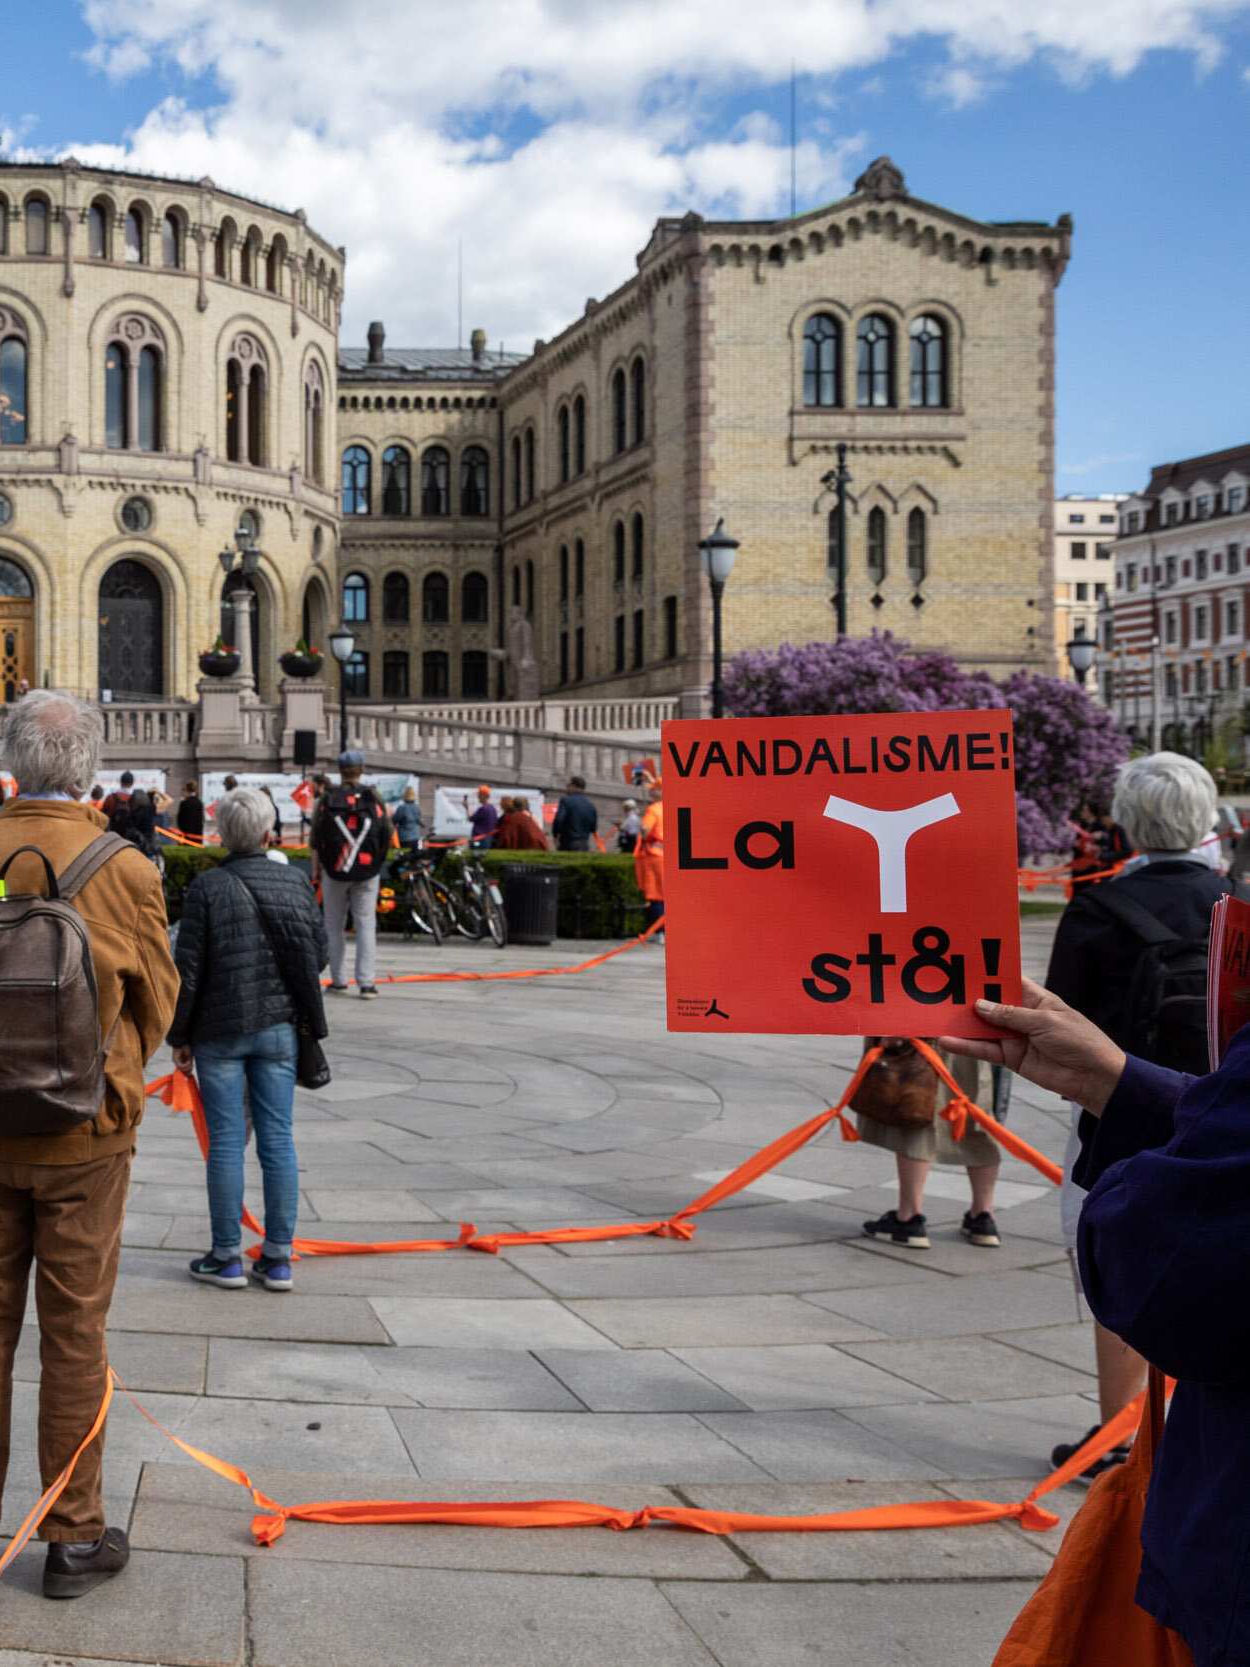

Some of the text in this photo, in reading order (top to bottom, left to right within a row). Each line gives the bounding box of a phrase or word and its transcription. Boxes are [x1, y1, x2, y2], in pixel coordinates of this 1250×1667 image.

[668, 732, 1010, 778] VANDALISME!
[678, 807, 795, 870] La
[1223, 924, 1250, 978] VA
